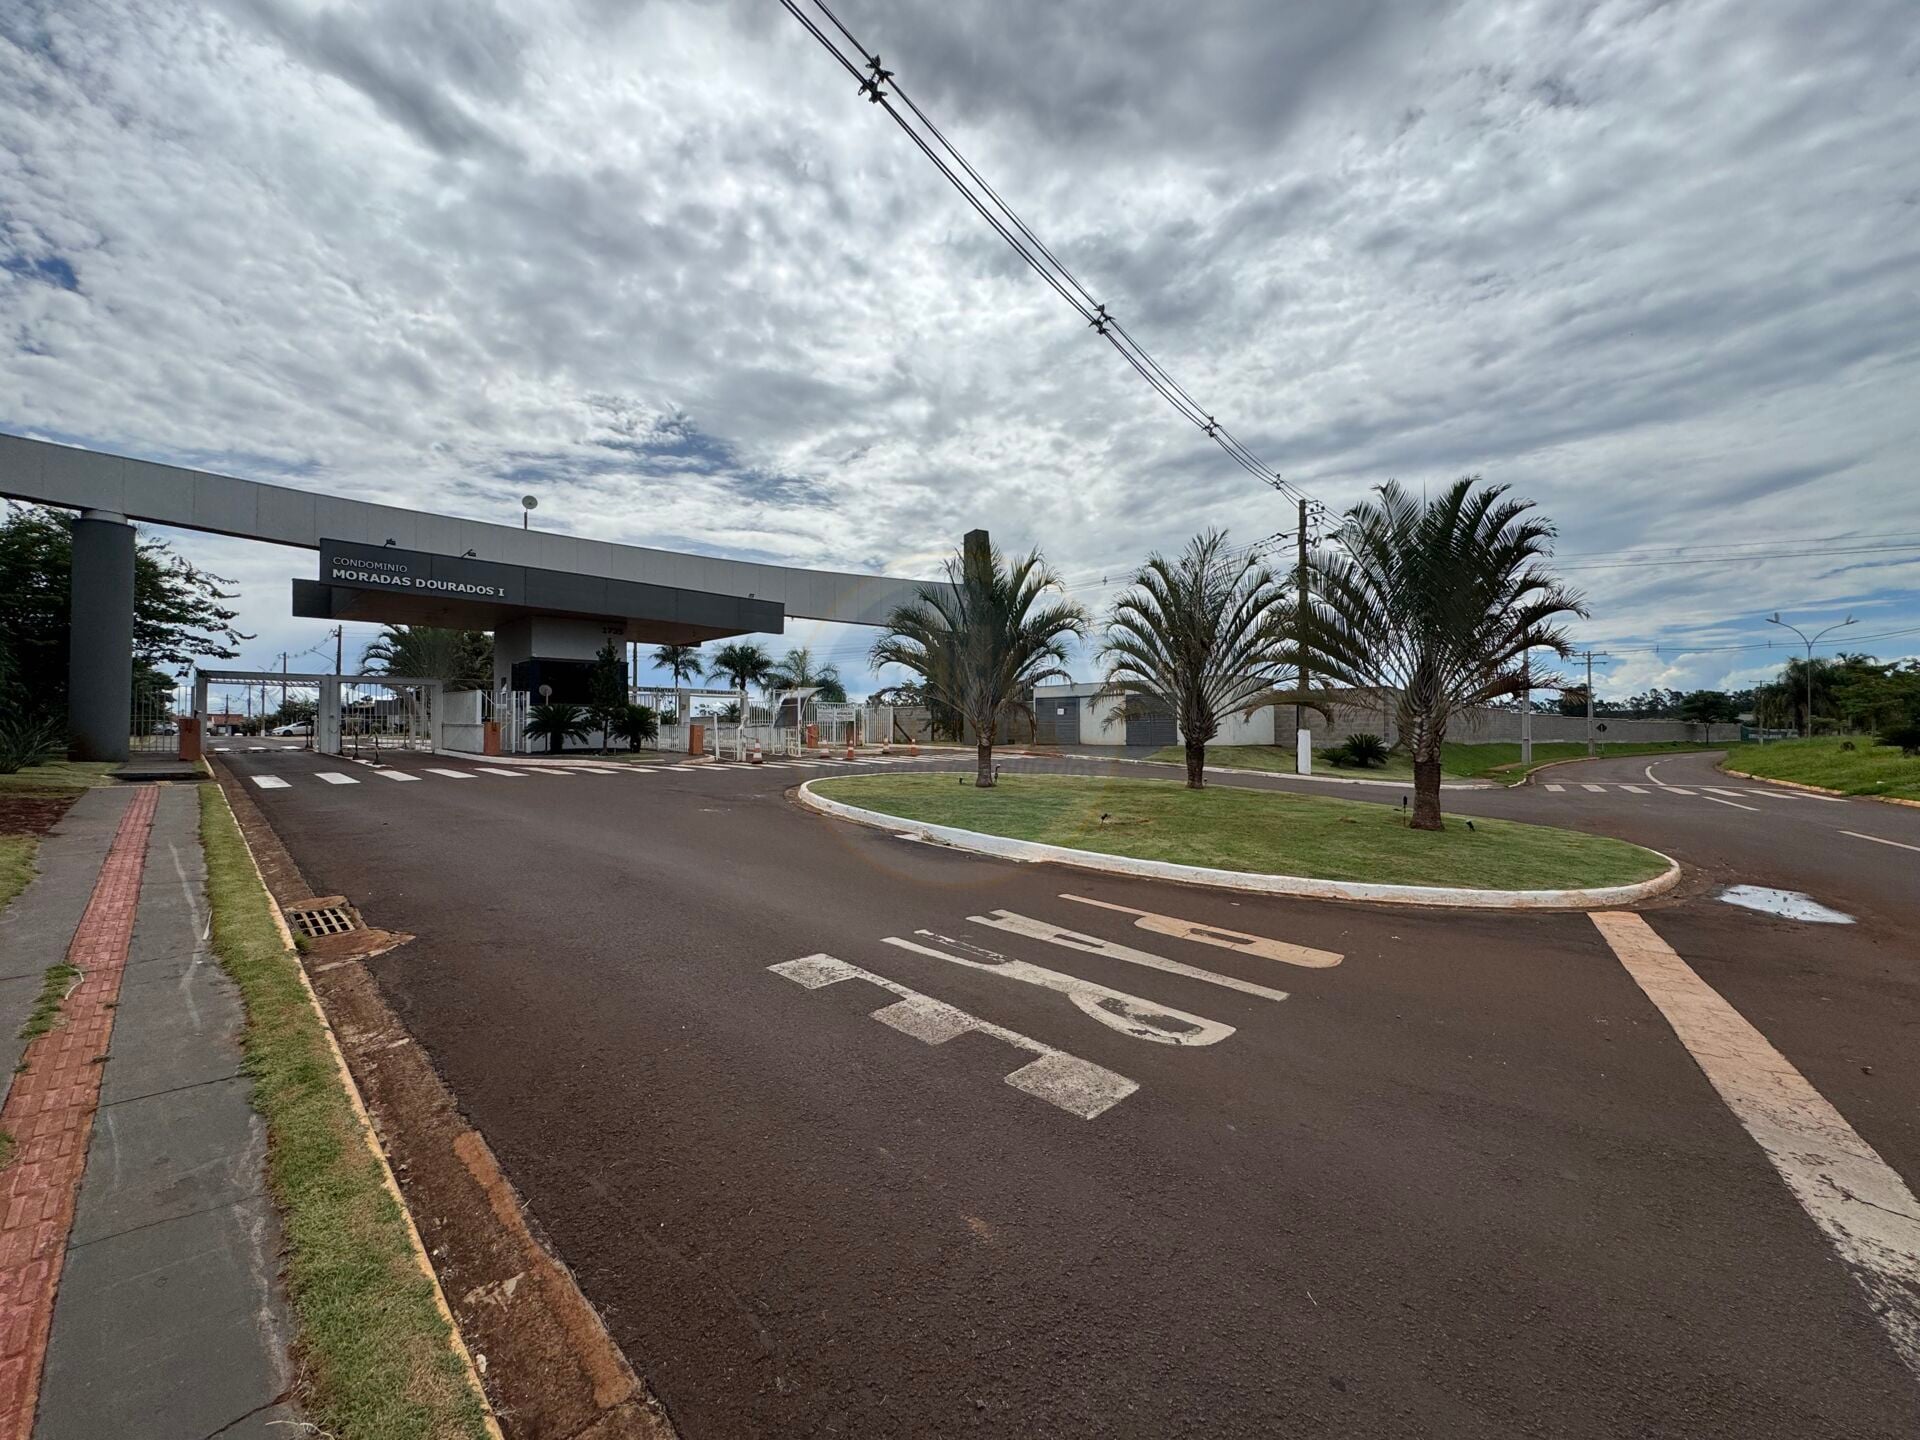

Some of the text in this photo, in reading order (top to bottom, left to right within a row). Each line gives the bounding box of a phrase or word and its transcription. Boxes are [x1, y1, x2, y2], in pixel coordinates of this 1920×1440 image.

[332, 557, 408, 573] CONDOMINIO
[332, 568, 505, 597] MORADAS DOURADOS I
[766, 893, 1345, 1120] PARE
